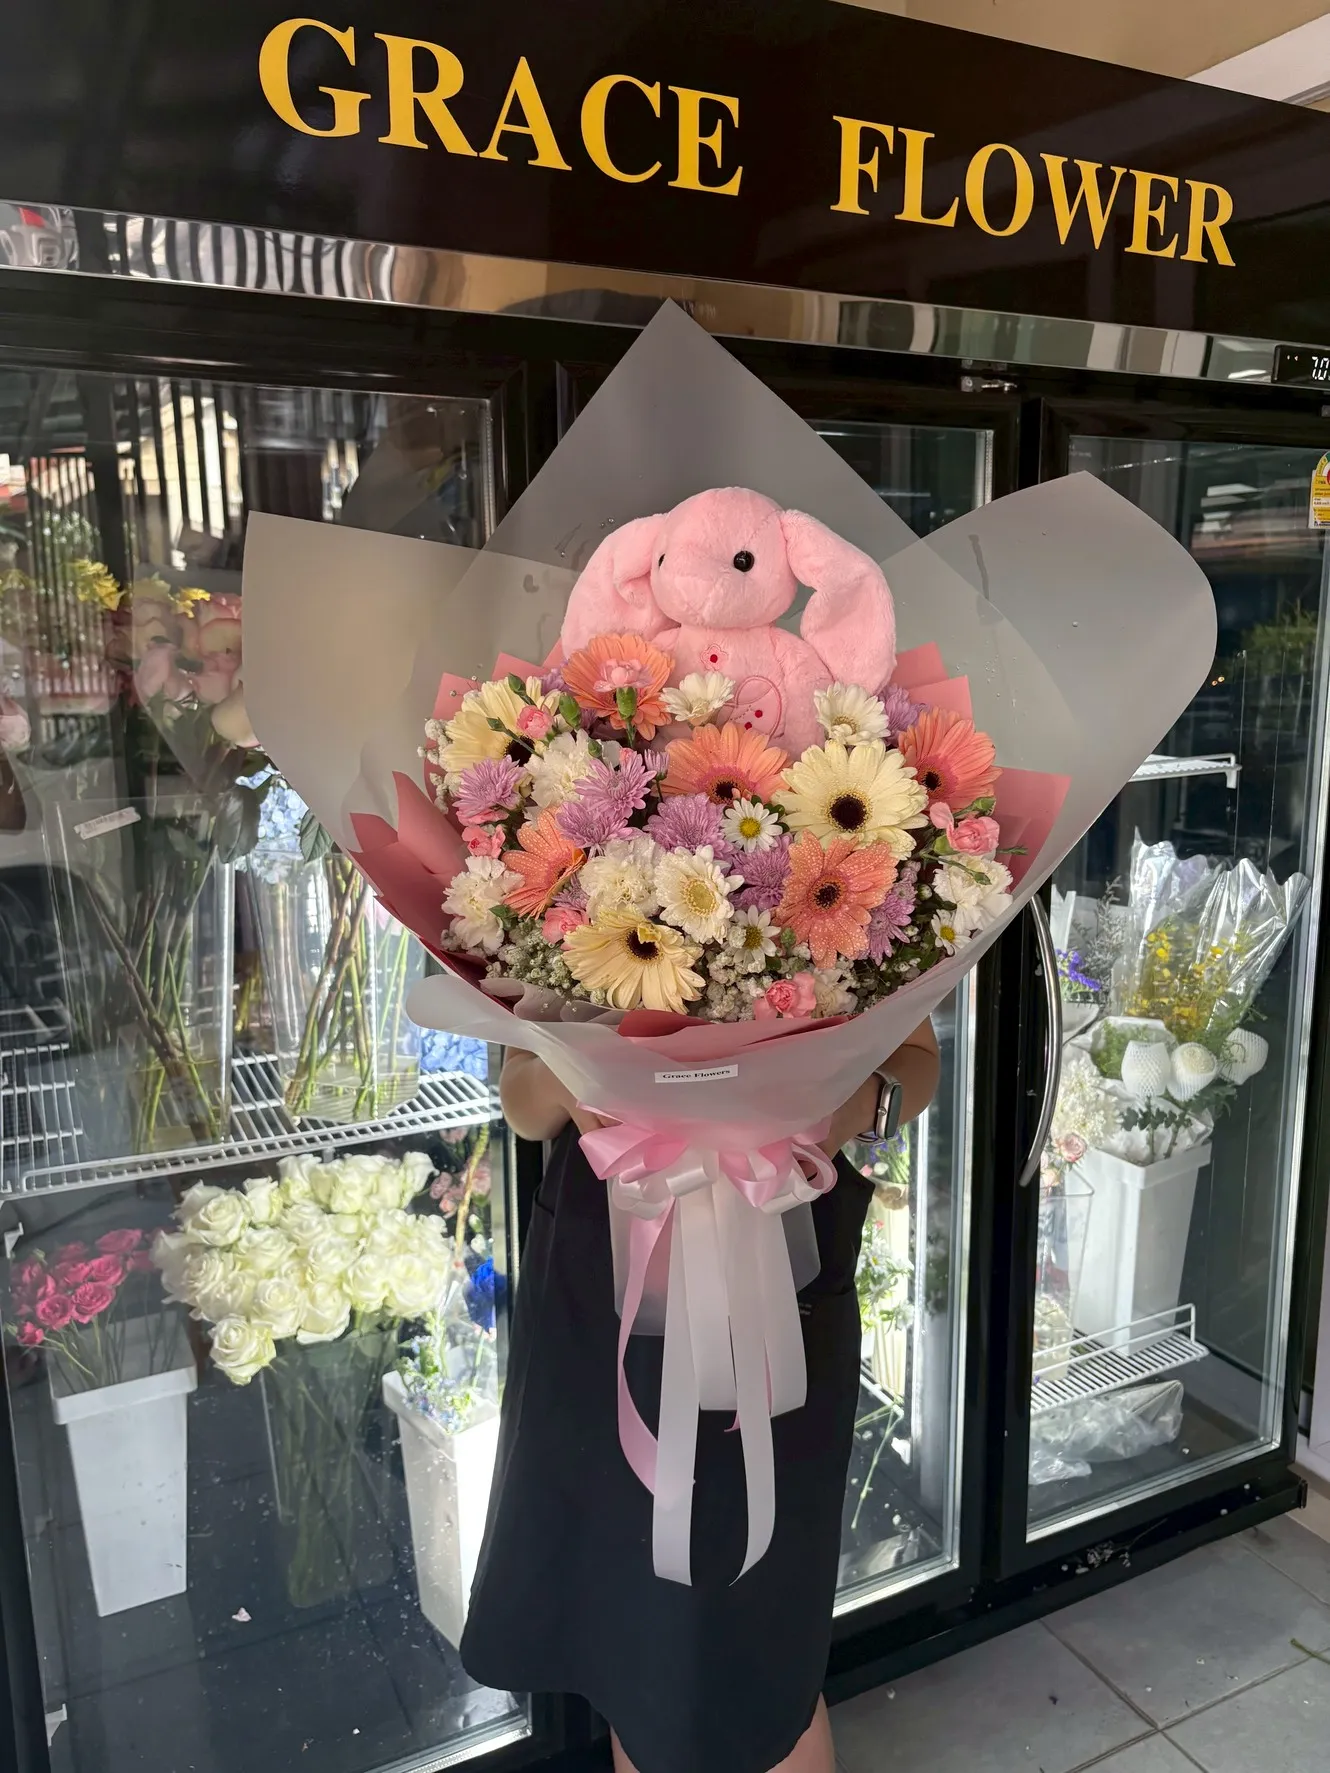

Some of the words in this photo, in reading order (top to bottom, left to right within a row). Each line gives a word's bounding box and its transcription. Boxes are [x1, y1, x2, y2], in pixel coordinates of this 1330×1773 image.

[259, 18, 743, 196] GRACE
[831, 115, 1235, 267] FLOWER
[694, 1069, 731, 1078] Flowers
